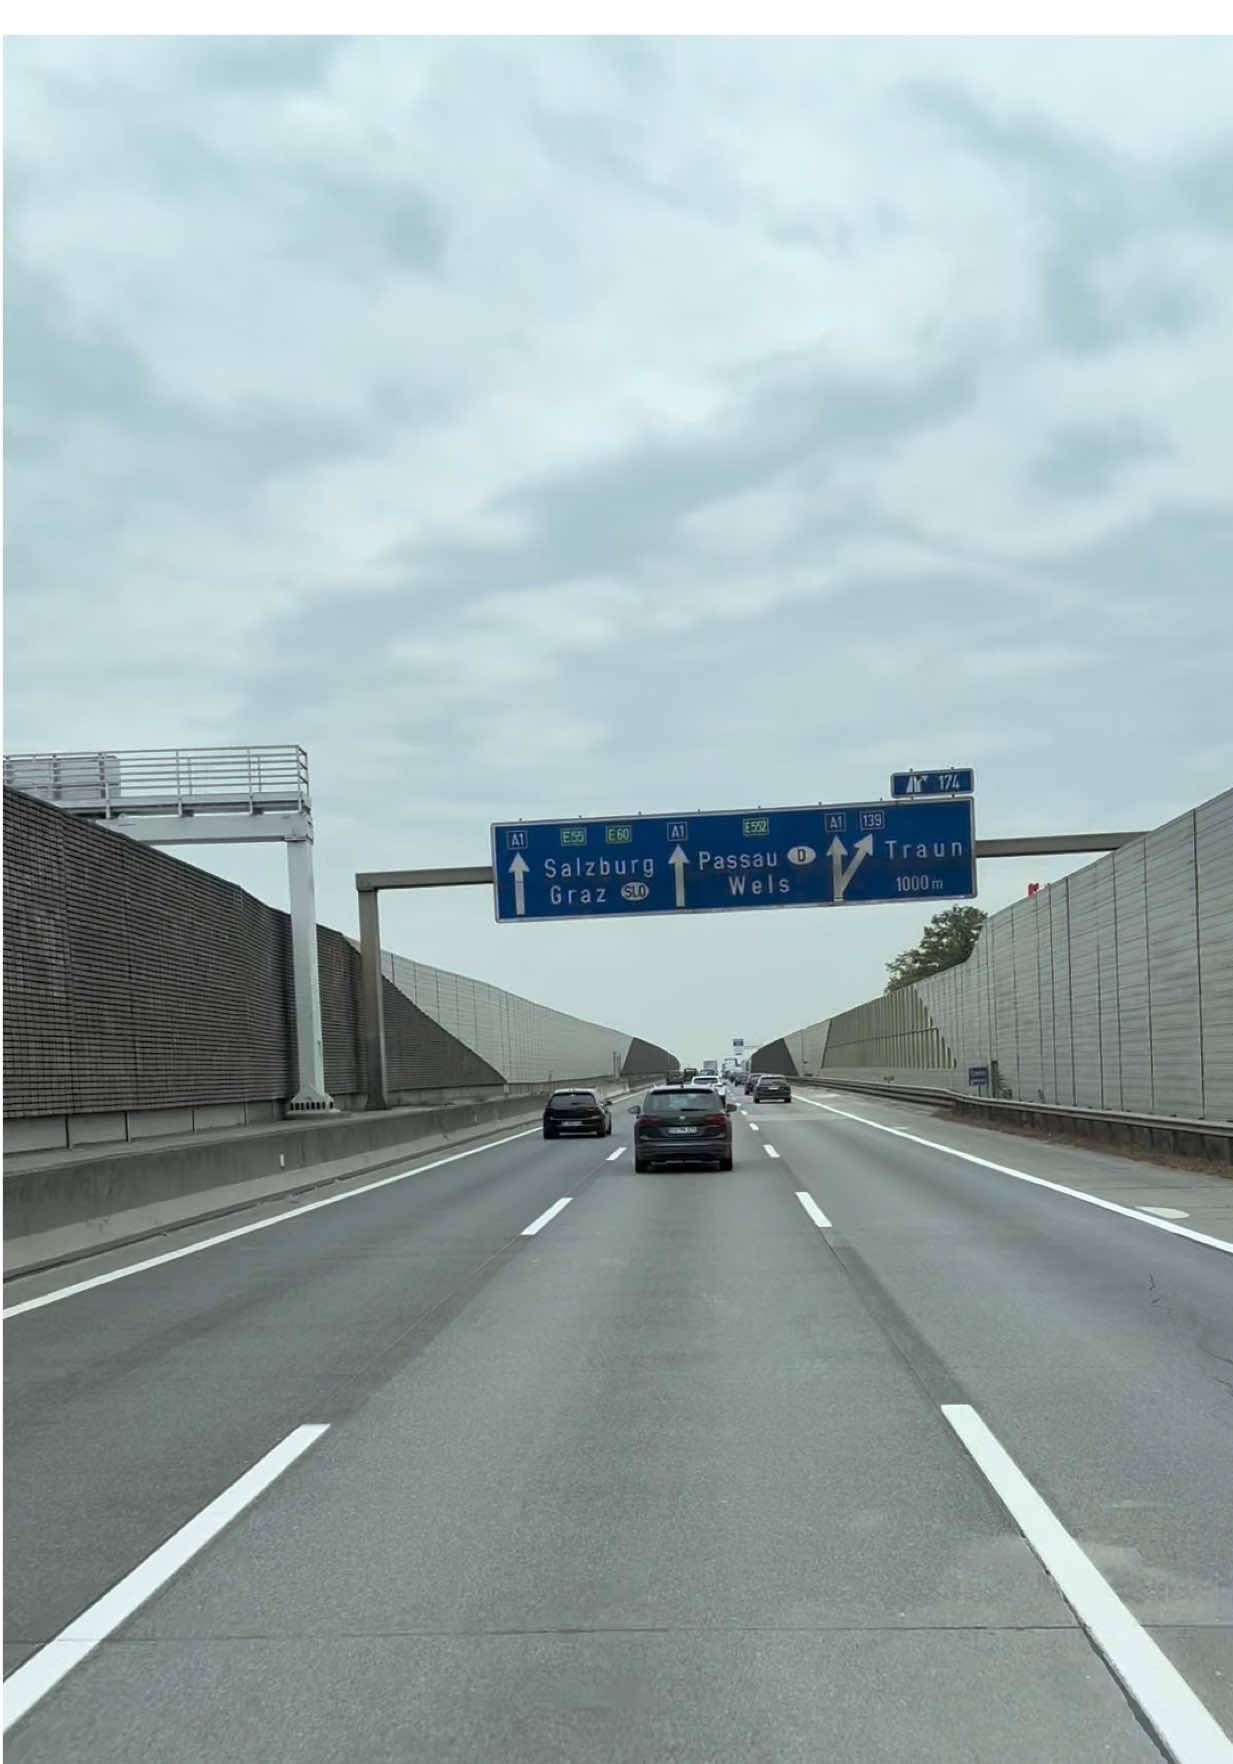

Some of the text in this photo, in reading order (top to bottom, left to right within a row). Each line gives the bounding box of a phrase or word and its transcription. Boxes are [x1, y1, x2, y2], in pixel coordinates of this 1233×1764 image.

[939, 774, 960, 790] 174
[829, 816, 843, 829] A1
[862, 814, 882, 828] 139
[671, 824, 685, 838] A1
[511, 832, 524, 846] A1
[797, 849, 807, 862] D
[884, 840, 962, 860] Traun
[544, 856, 654, 878] Salzburg
[699, 851, 778, 870] Passau
[624, 885, 647, 898] SLO
[728, 874, 791, 896] Wels
[550, 885, 607, 905] Graz
